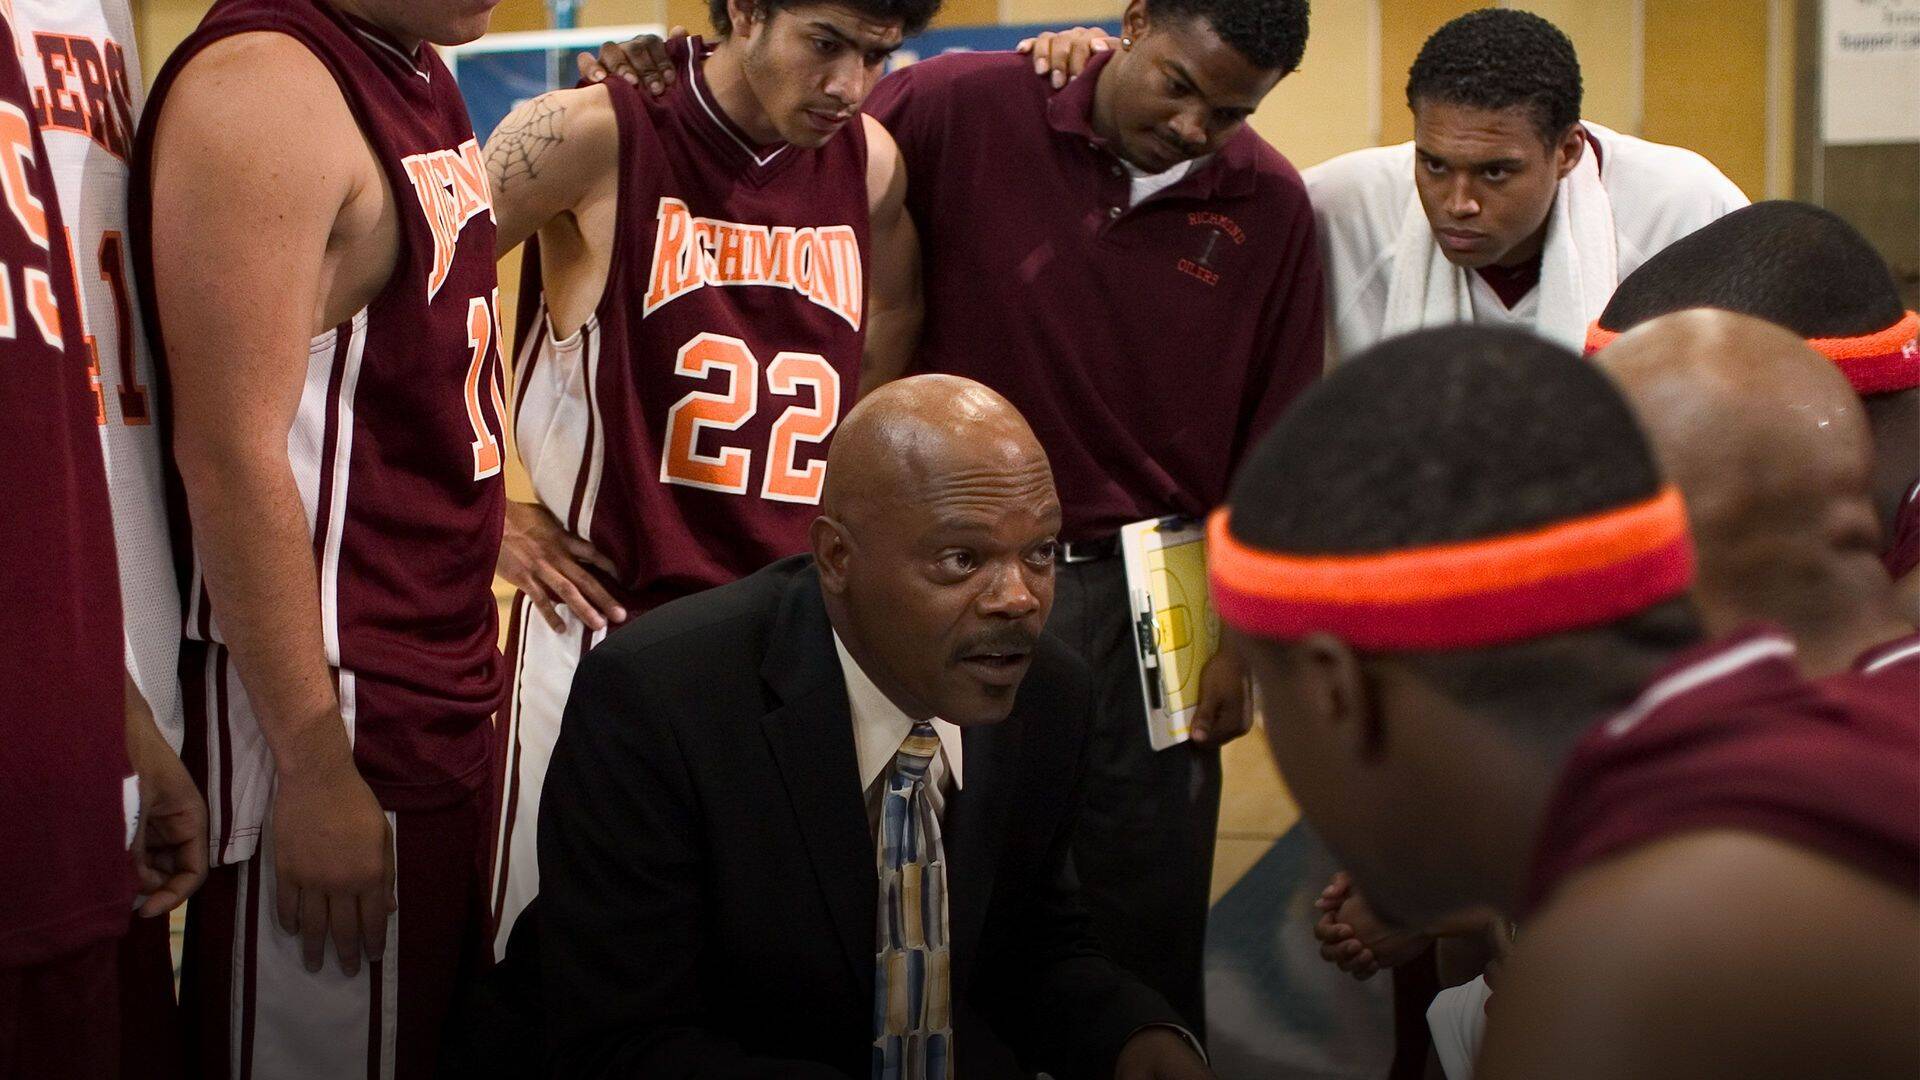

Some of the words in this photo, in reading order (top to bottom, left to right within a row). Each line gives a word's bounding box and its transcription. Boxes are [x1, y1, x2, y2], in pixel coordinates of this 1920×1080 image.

[643, 197, 863, 332] RICHMOND
[1187, 212, 1245, 245] RICHMOND
[1177, 259, 1220, 287] OILERS
[660, 332, 841, 505] 22
